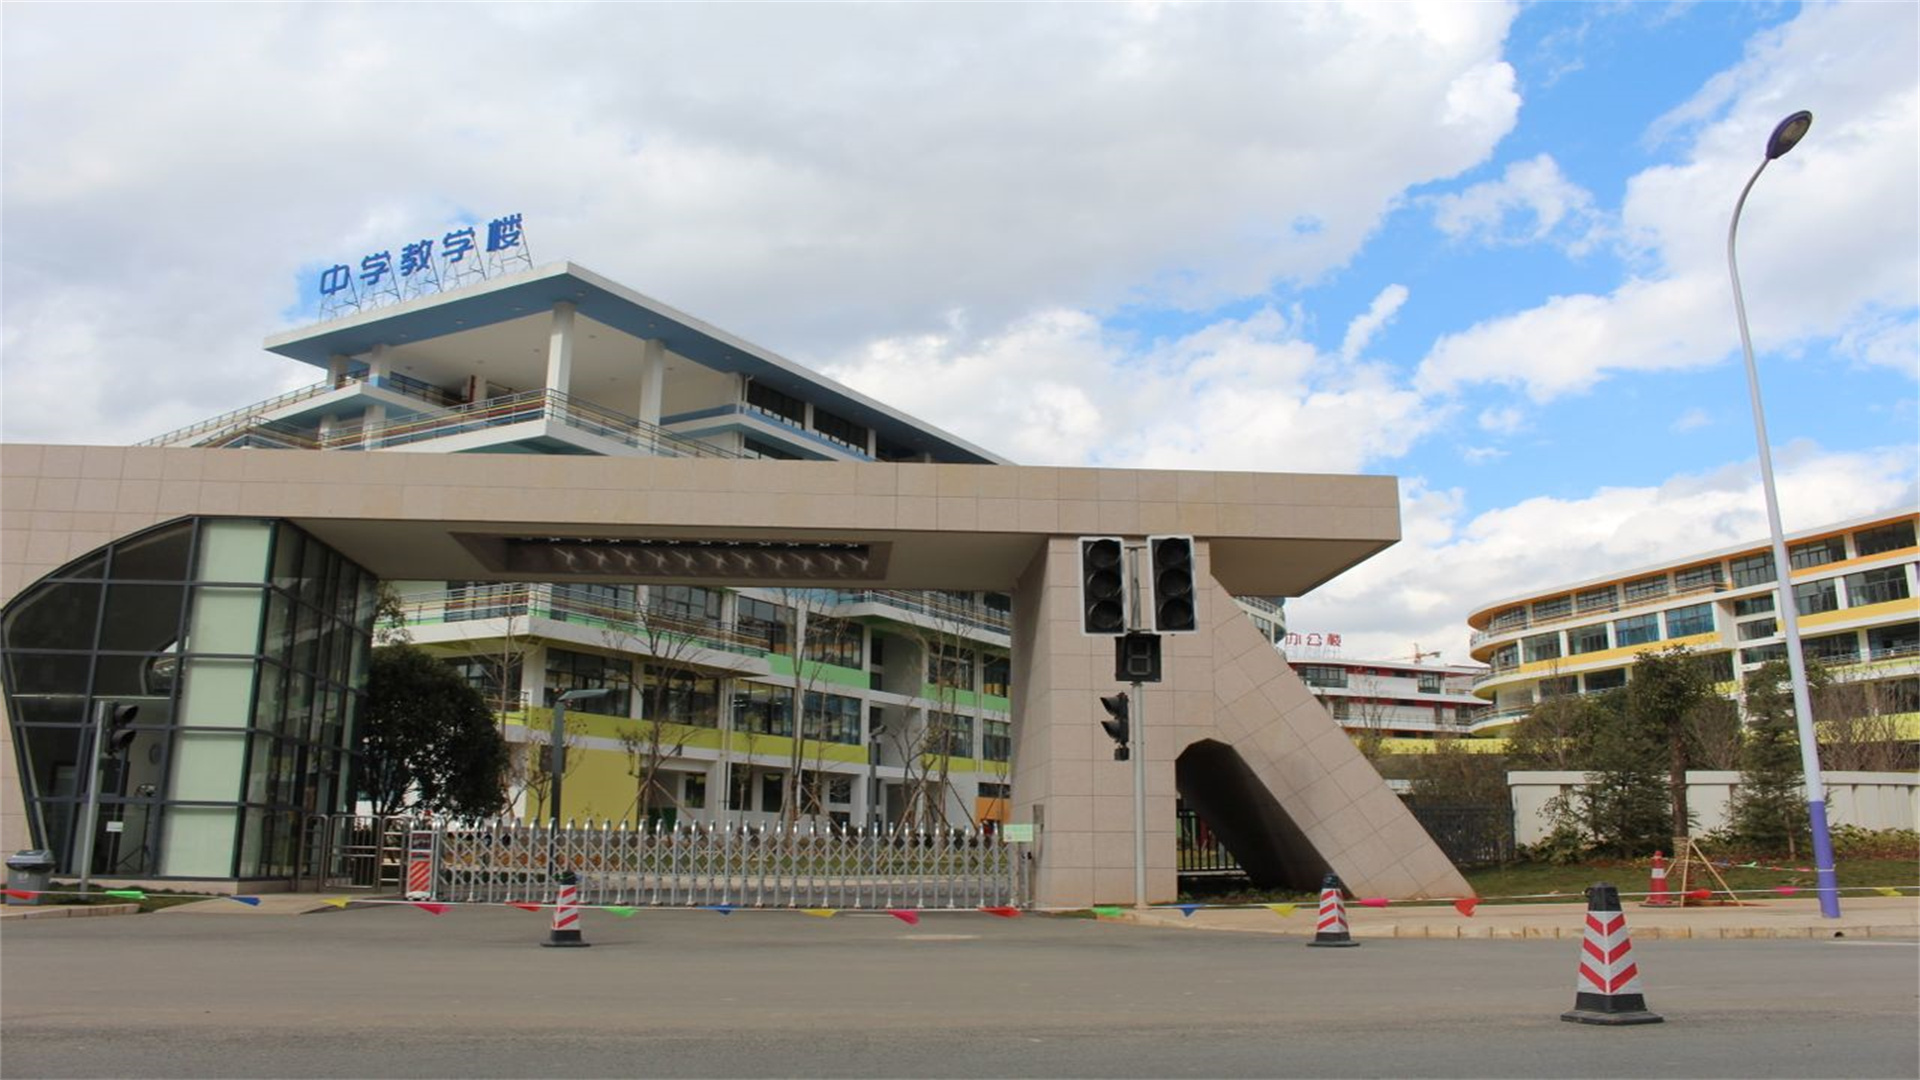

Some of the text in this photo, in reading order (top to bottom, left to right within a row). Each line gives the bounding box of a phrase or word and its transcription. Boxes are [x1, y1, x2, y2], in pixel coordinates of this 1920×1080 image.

[320, 213, 523, 296] 中学教学楼
